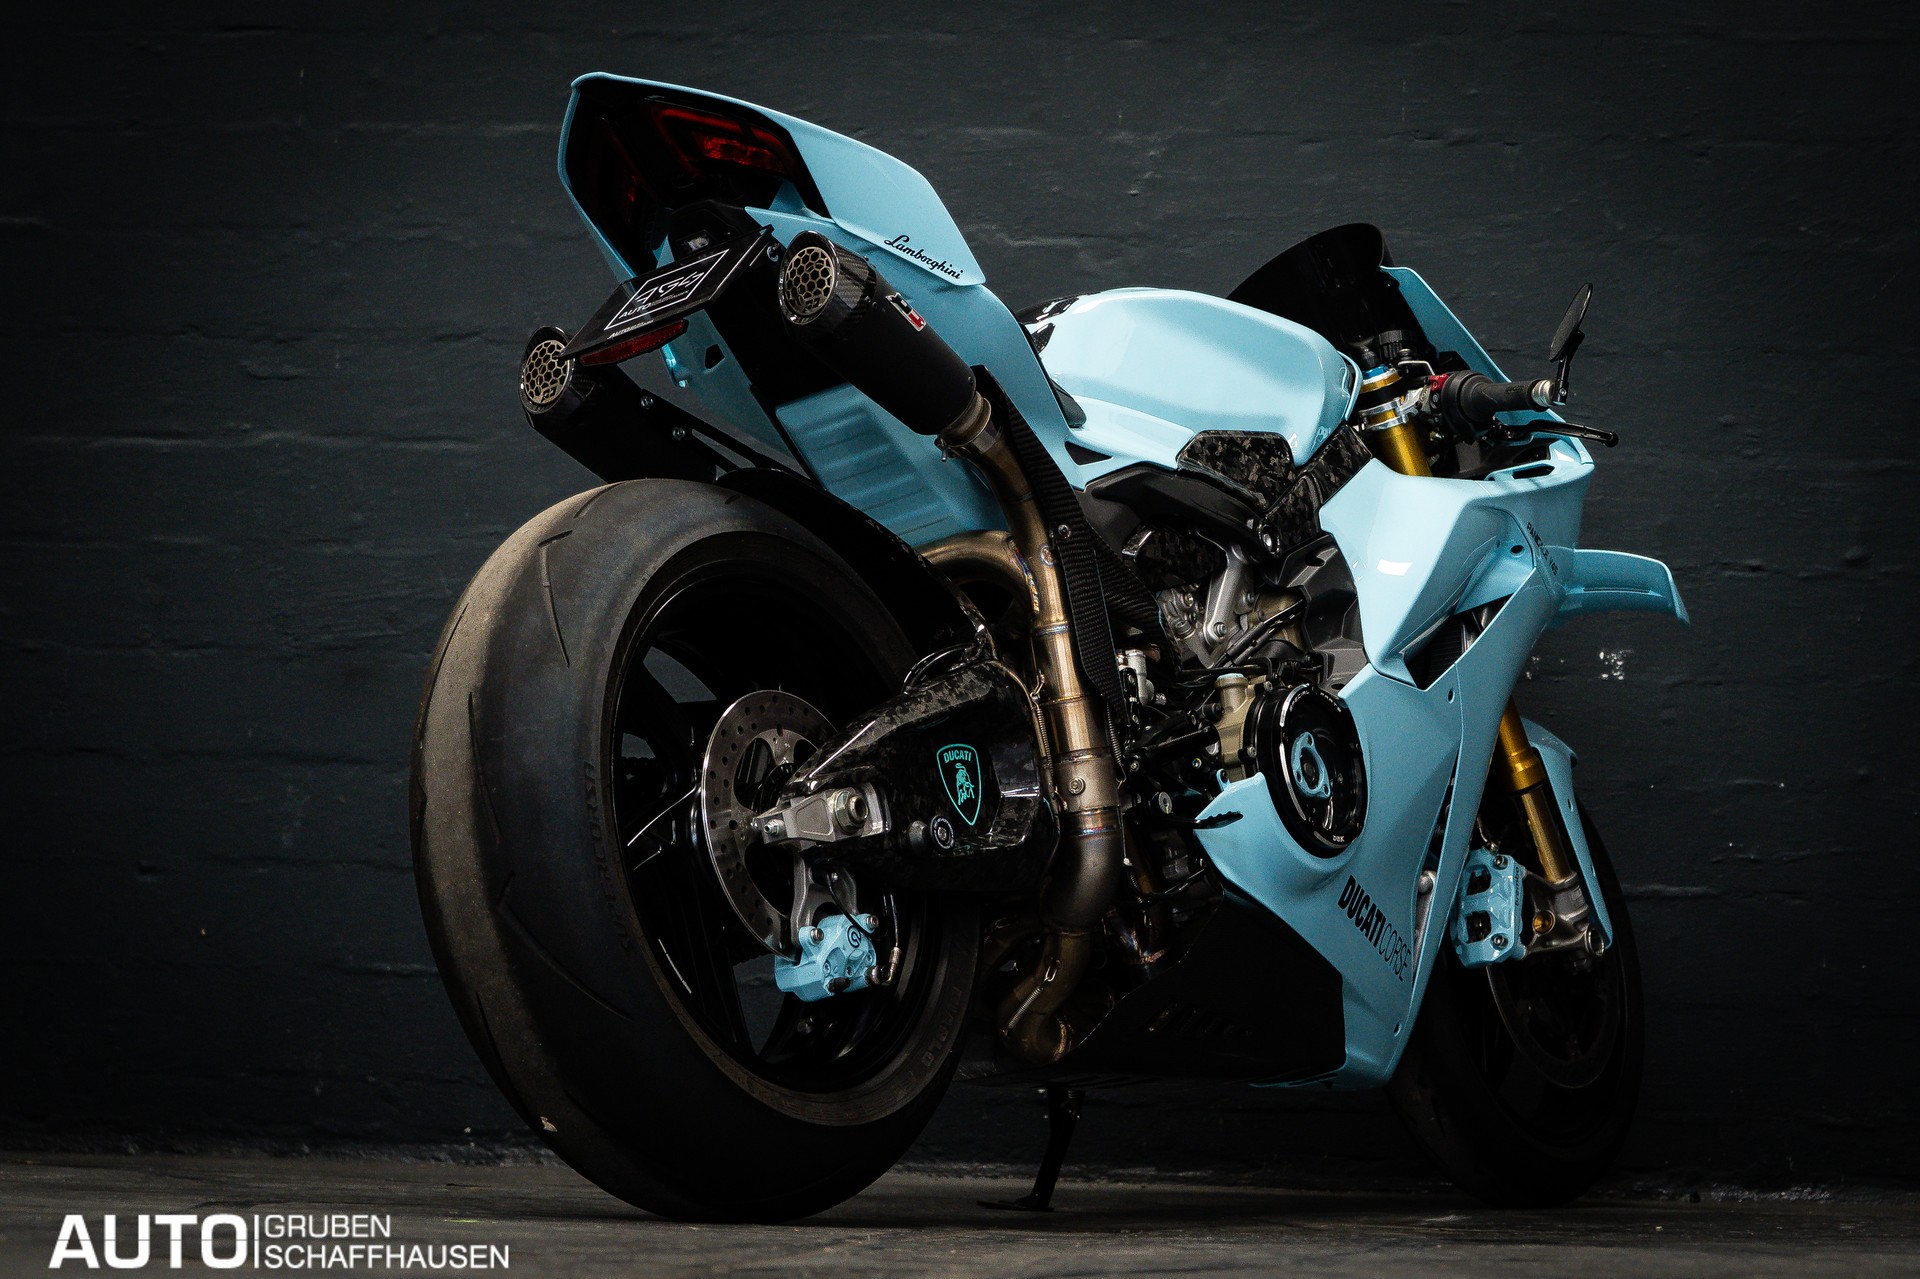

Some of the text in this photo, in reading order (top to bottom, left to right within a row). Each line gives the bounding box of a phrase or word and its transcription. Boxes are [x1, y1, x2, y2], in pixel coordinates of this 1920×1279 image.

[884, 235, 963, 279] Lamborghini
[618, 302, 652, 320] AUTO
[943, 749, 972, 764] DUCATI
[1338, 875, 1387, 948] DUCATI
